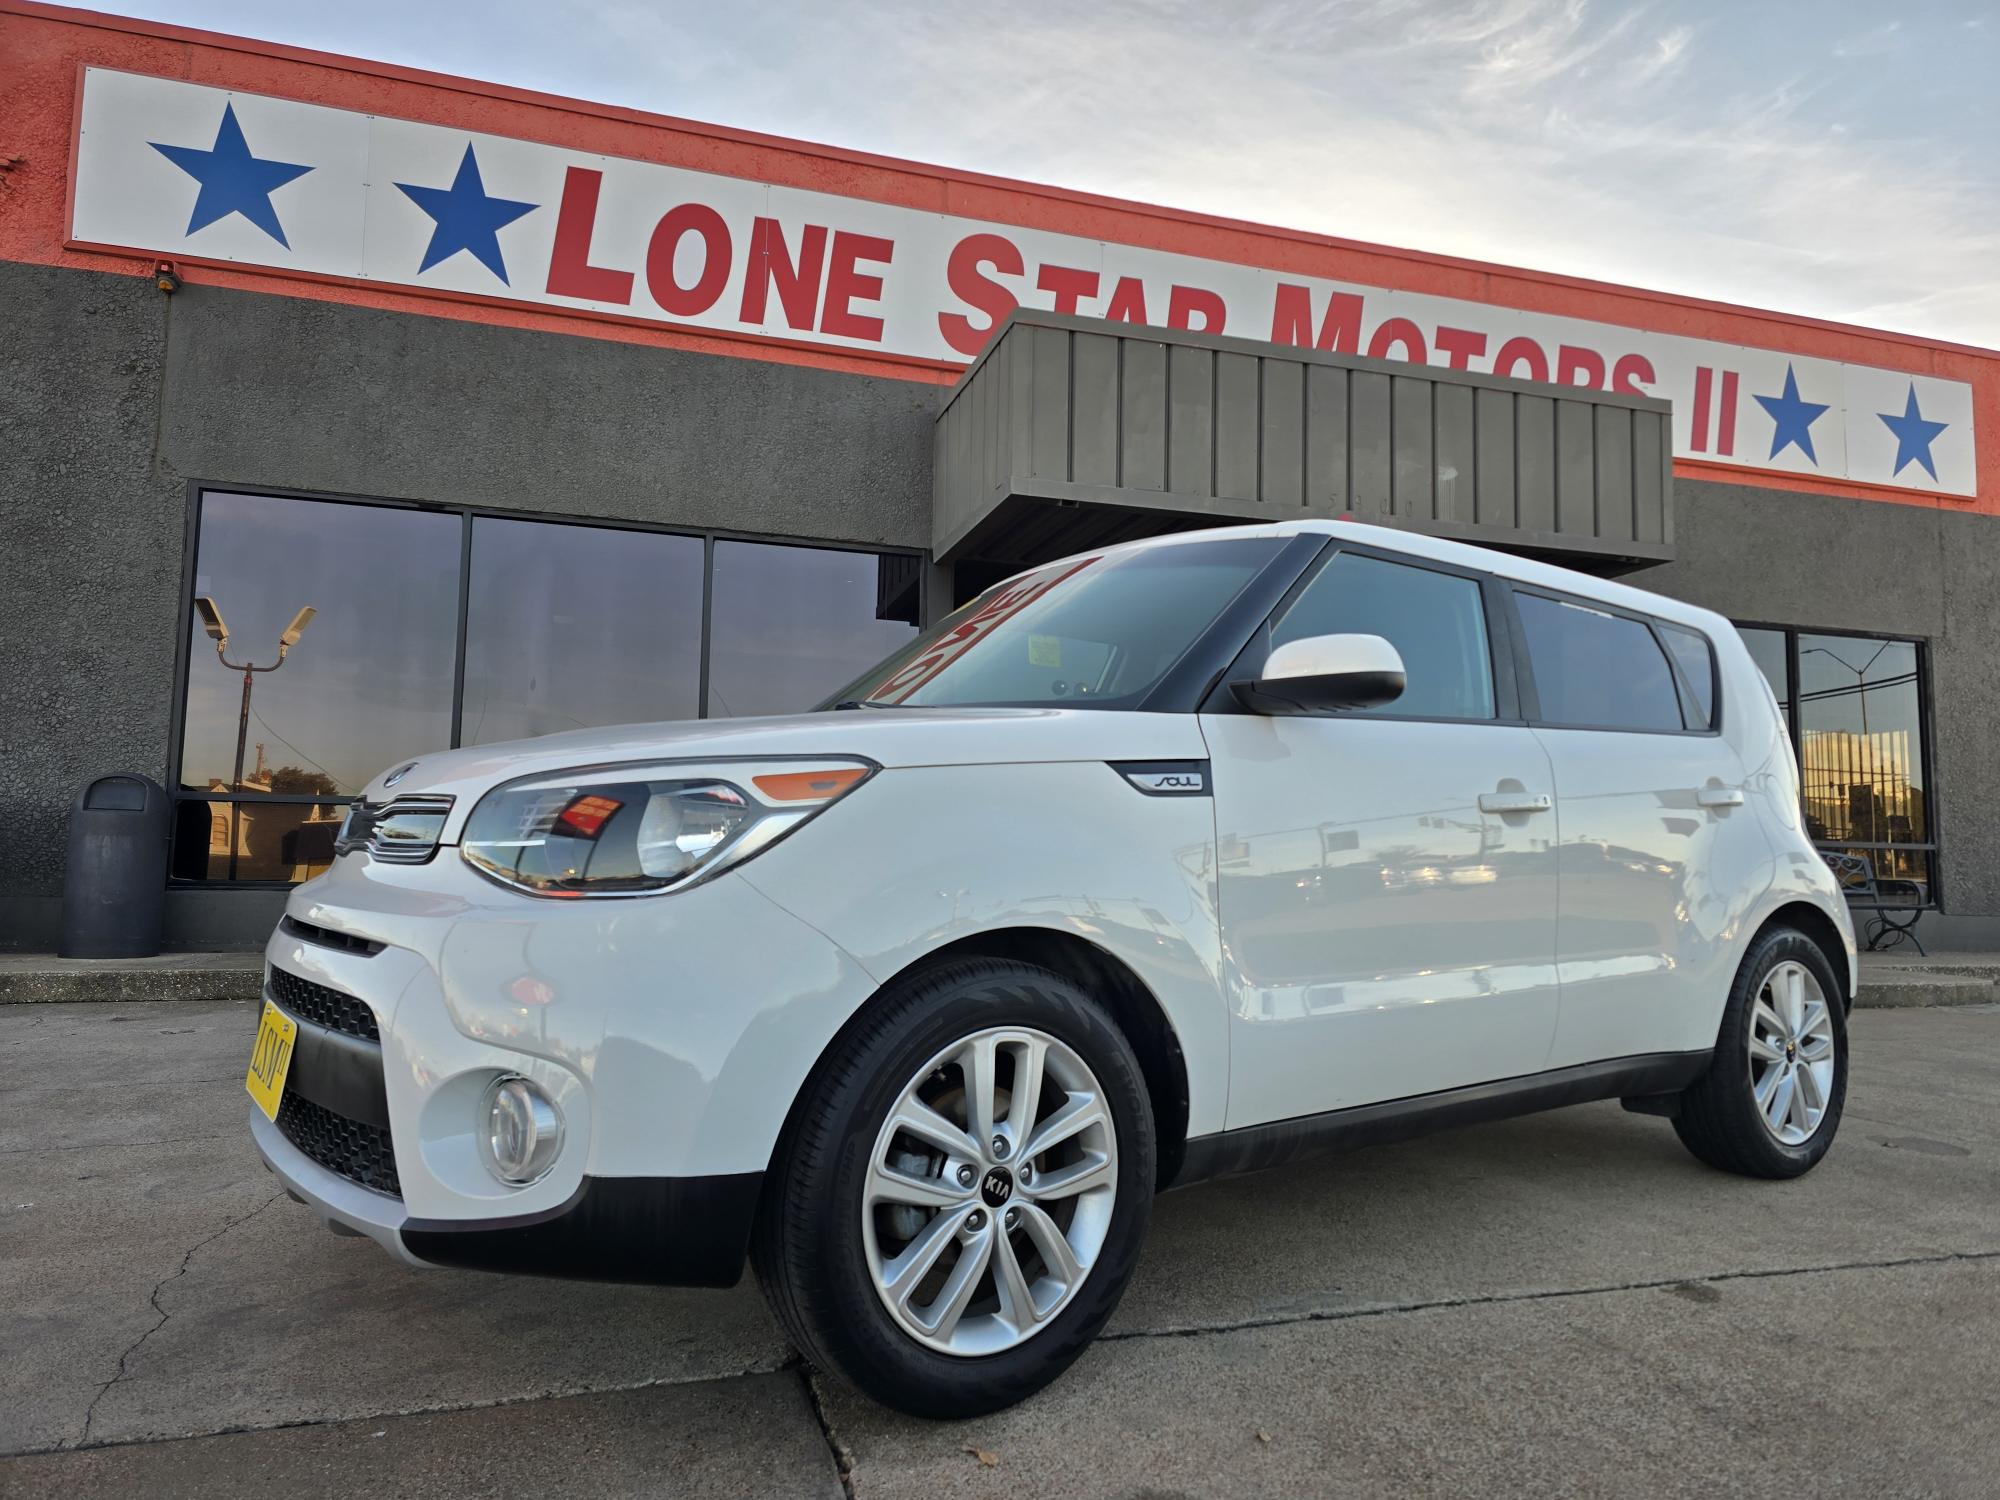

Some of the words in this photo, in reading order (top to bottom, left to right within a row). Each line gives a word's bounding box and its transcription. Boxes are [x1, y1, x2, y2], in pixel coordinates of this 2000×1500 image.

[546, 165, 895, 343] LONE
[1689, 366, 1739, 457] II
[985, 1175, 1010, 1199] KIA
